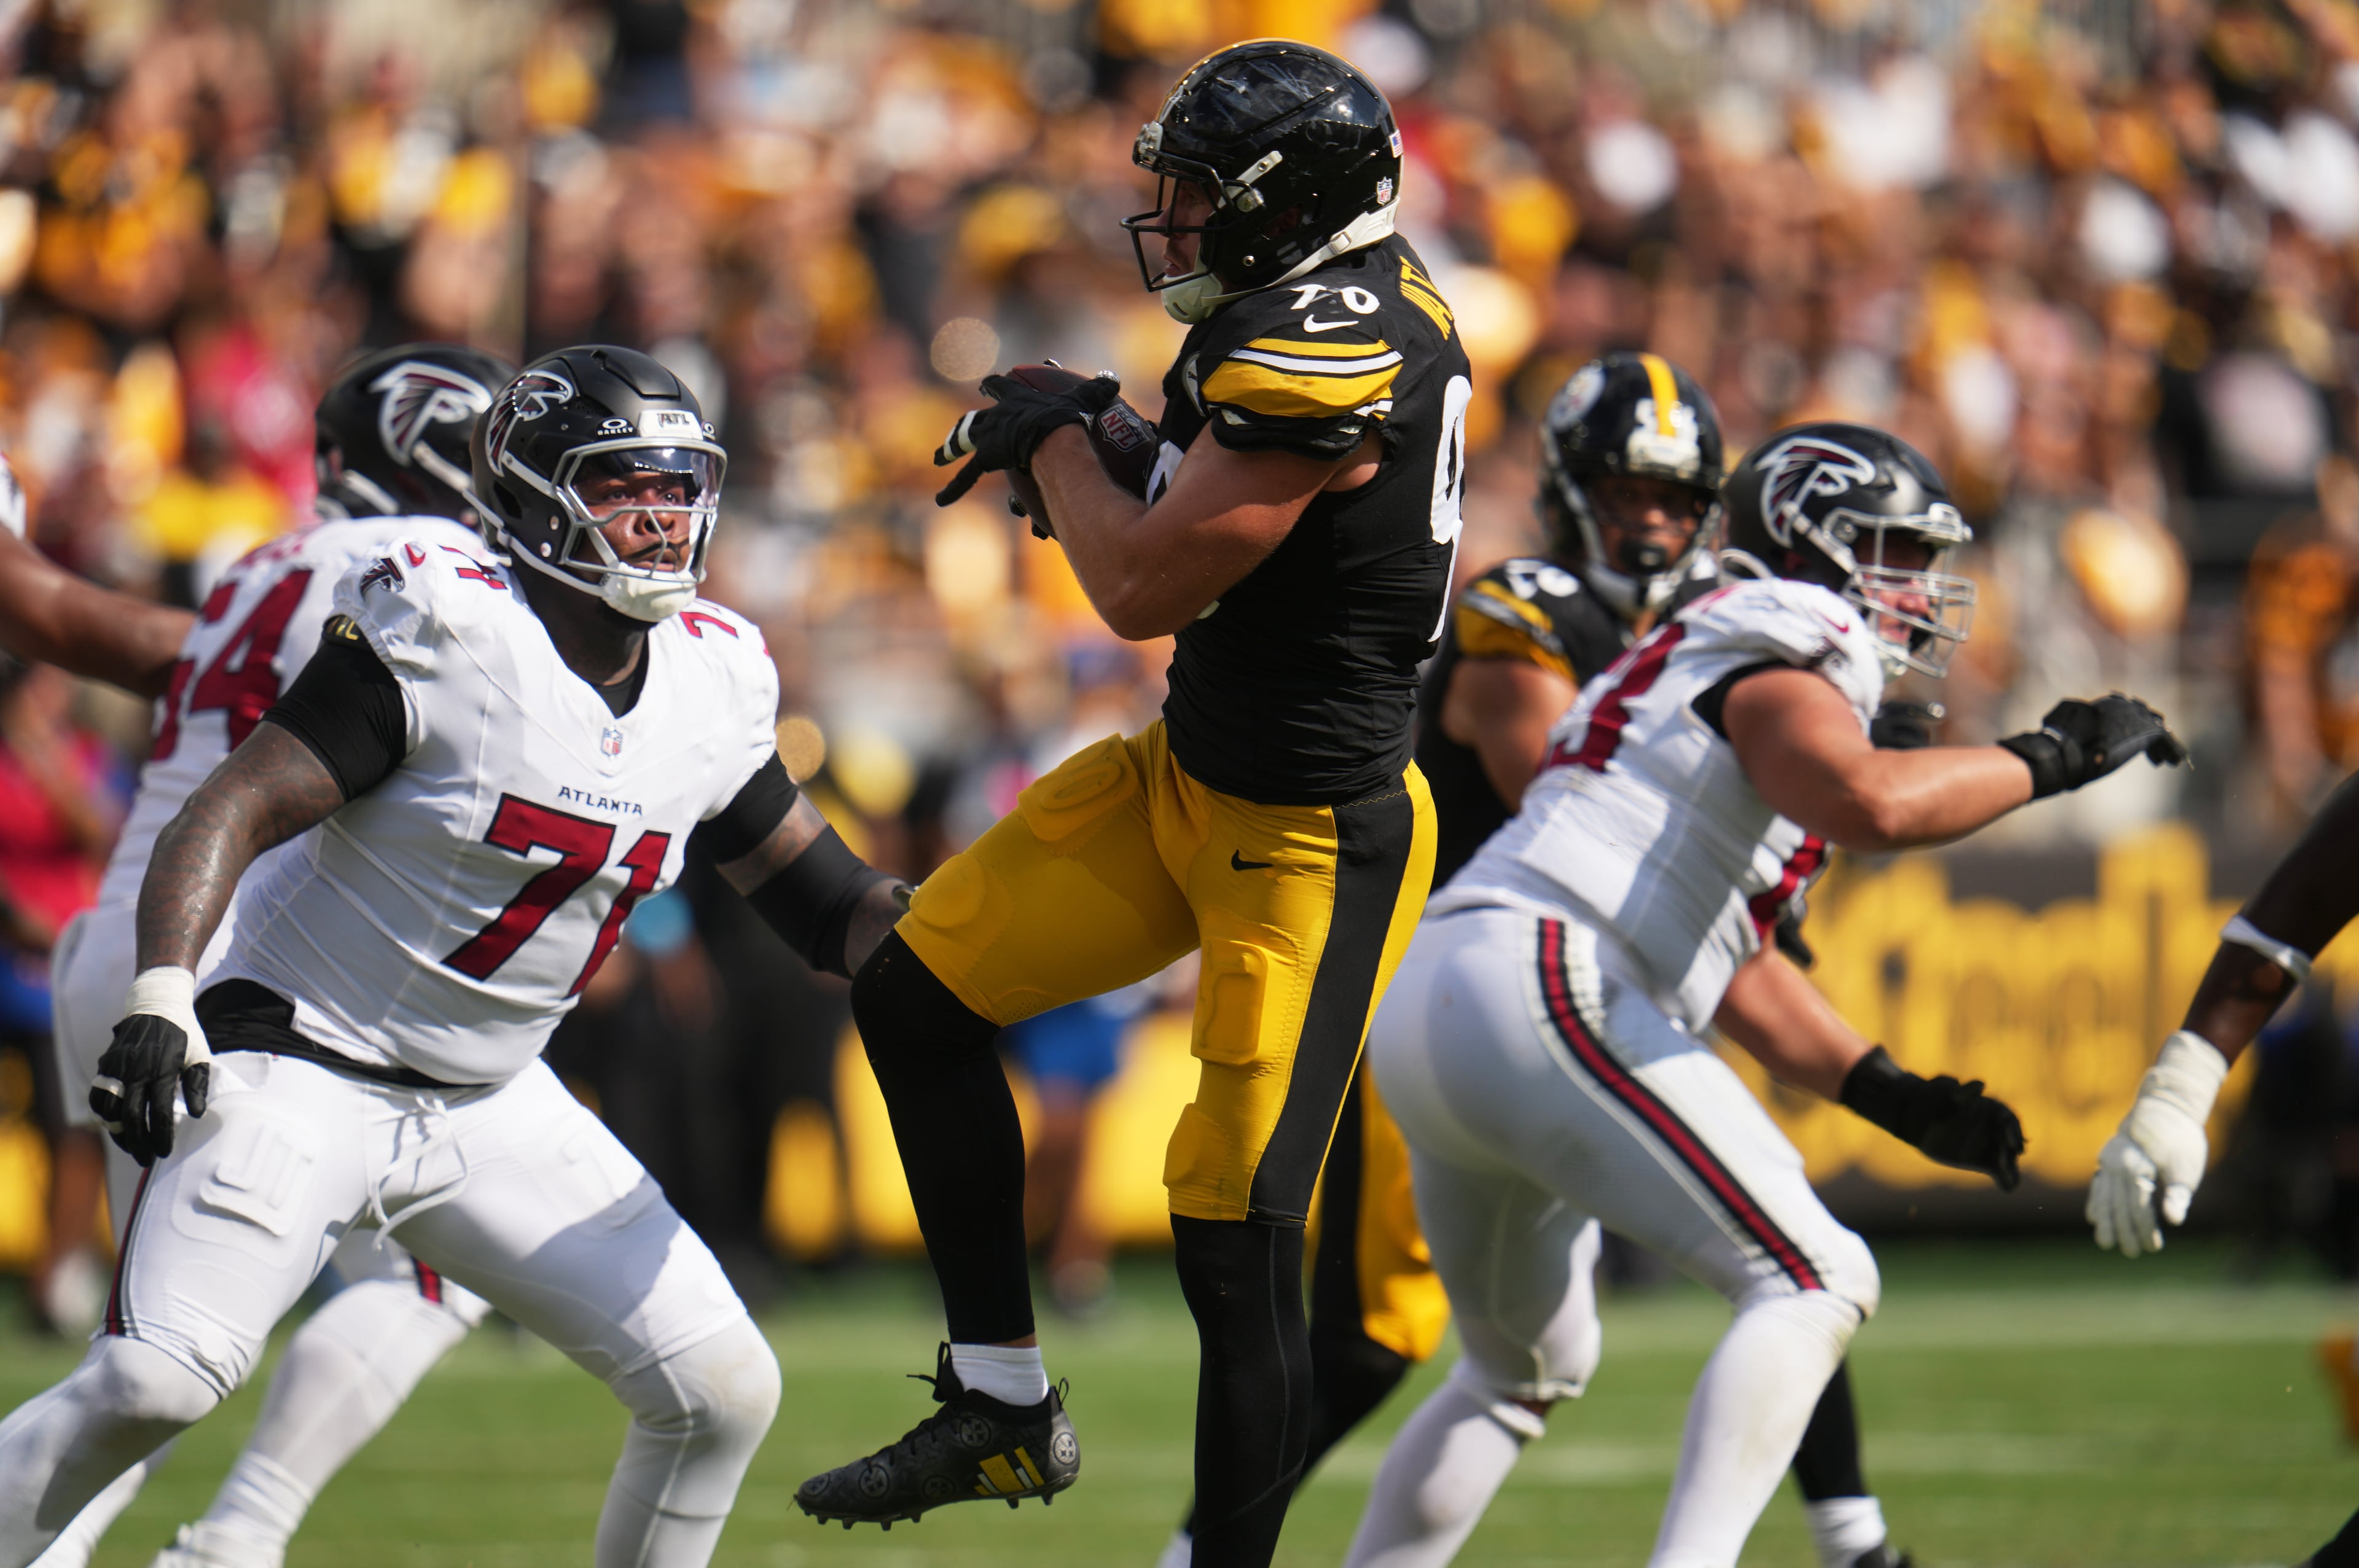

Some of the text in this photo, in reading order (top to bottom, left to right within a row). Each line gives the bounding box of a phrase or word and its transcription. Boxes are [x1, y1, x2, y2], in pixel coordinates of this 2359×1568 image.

[597, 426, 634, 435] OAKLEY
[1102, 412, 1135, 447] NFL
[558, 786, 643, 816] ATLANTA
[440, 792, 672, 1001] 71
